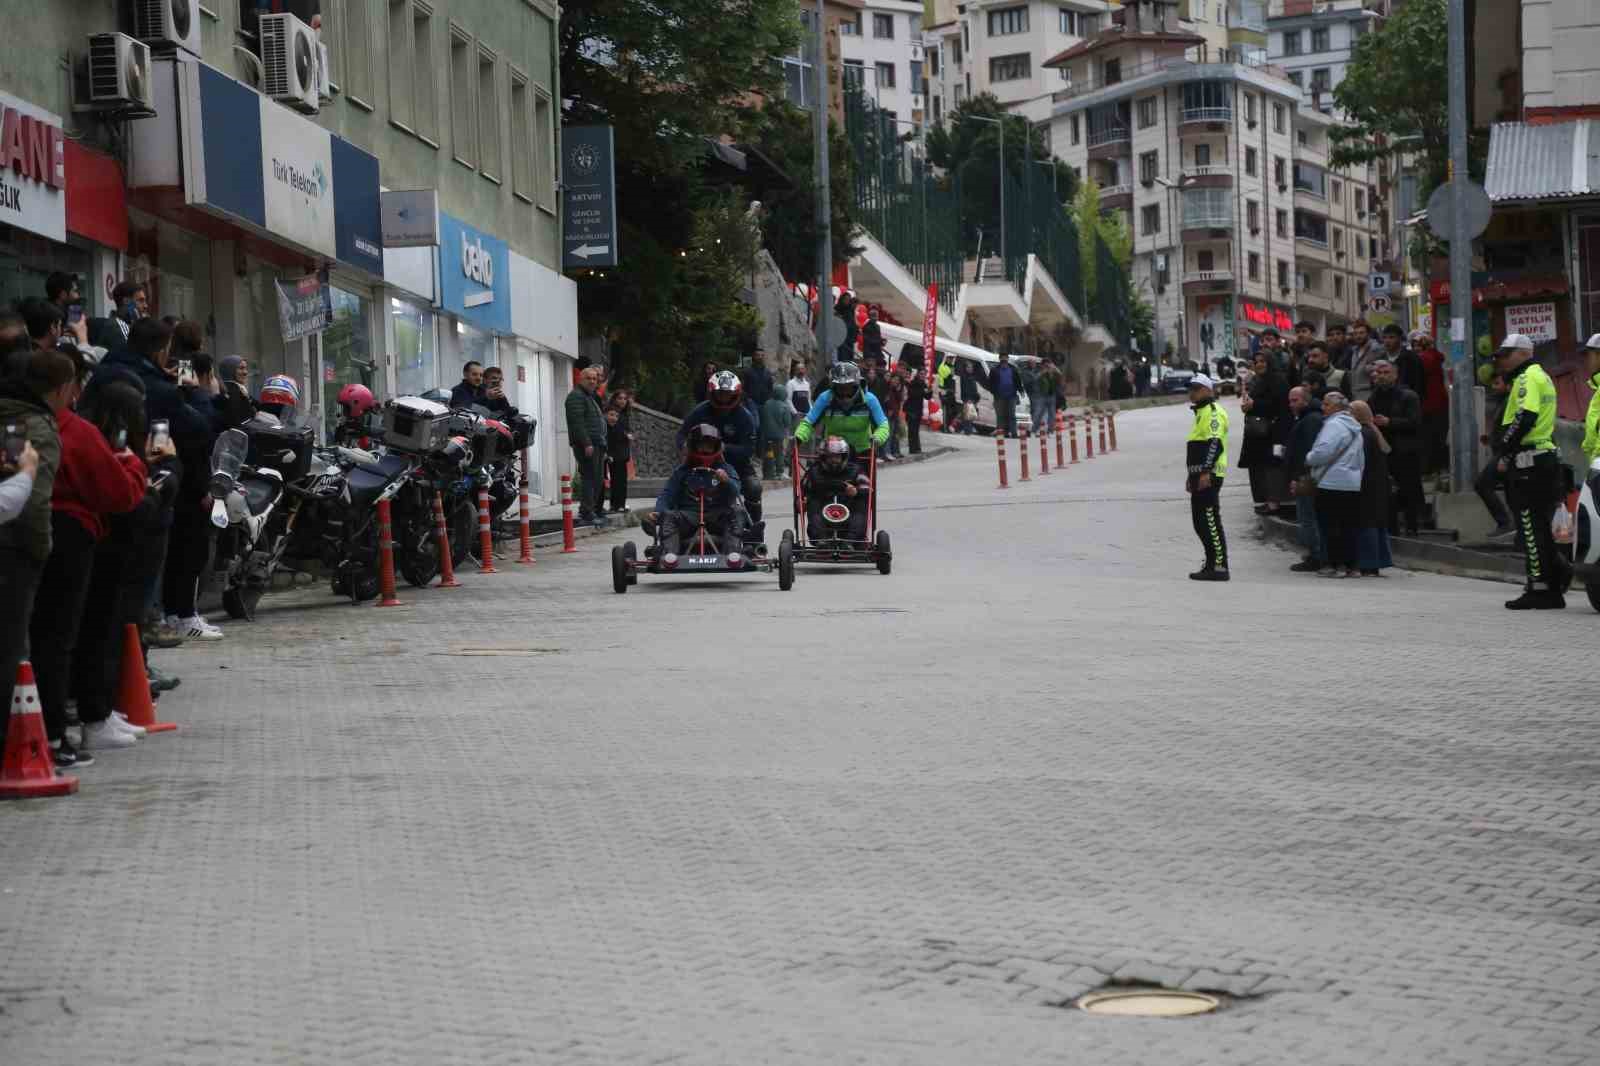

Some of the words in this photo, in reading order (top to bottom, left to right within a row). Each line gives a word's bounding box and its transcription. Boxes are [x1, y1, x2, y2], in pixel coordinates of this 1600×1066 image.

[0, 105, 64, 191] ANE
[272, 158, 288, 185] Türk
[288, 166, 319, 197] Telekom
[462, 231, 493, 290] beko
[1374, 277, 1385, 288] D
[1509, 303, 1552, 315] DEVREN
[1511, 314, 1552, 325] SATILIK
